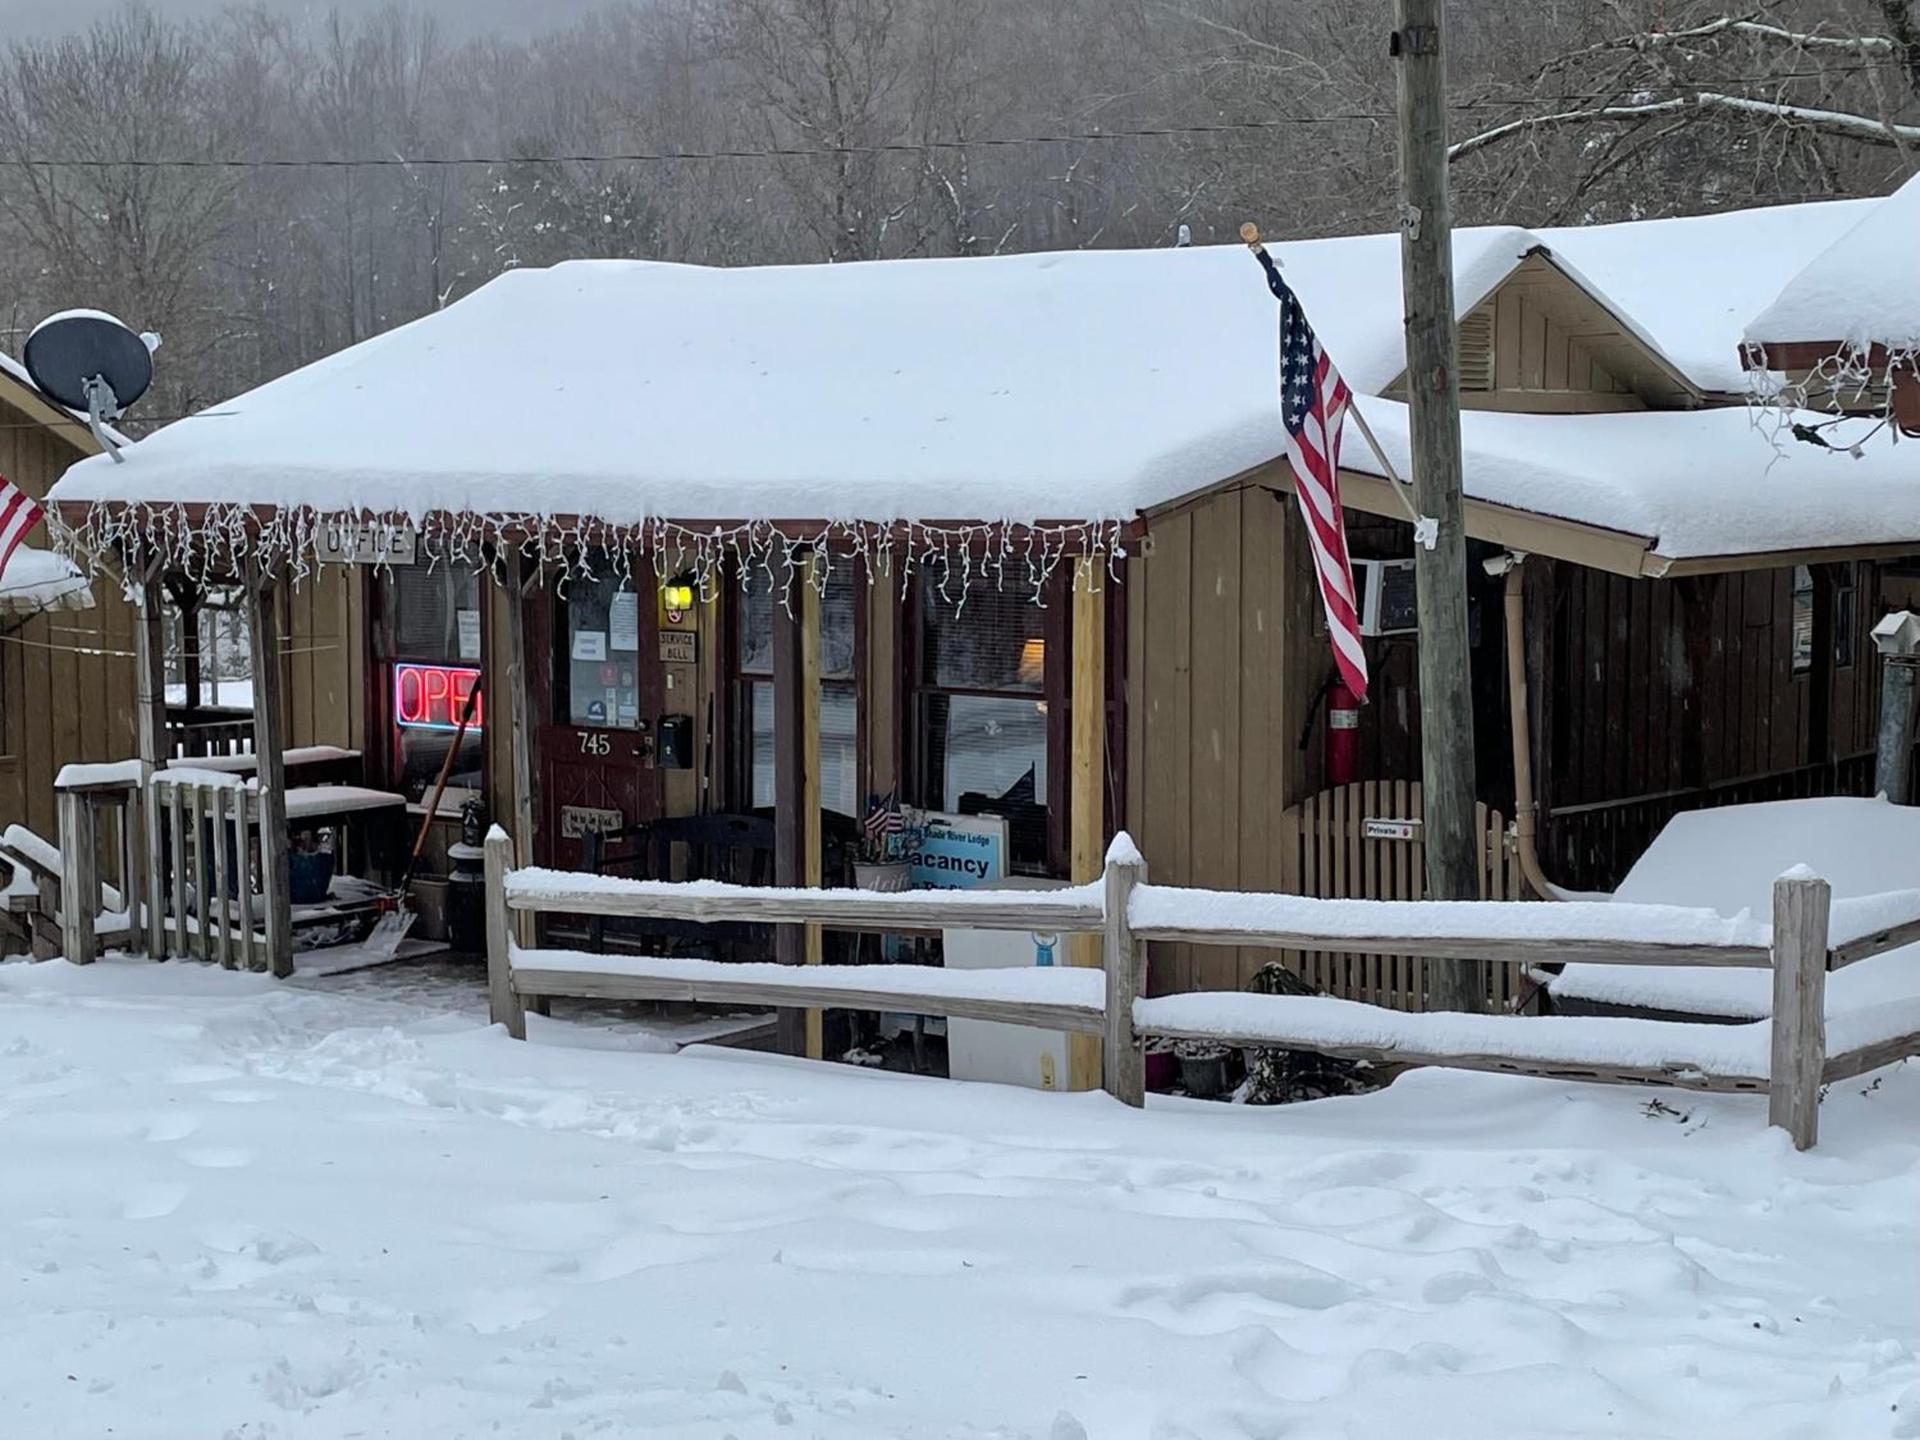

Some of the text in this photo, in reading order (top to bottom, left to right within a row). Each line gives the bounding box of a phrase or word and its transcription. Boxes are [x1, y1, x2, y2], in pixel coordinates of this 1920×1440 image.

[327, 528, 404, 554] OFICE
[660, 634, 693, 646] SERVICE
[667, 648, 689, 660] BELL
[577, 731, 611, 756] 745
[947, 830, 966, 843] River
[967, 832, 990, 847] Lodge
[1367, 826, 1397, 835] Private
[908, 851, 990, 879] acancy
